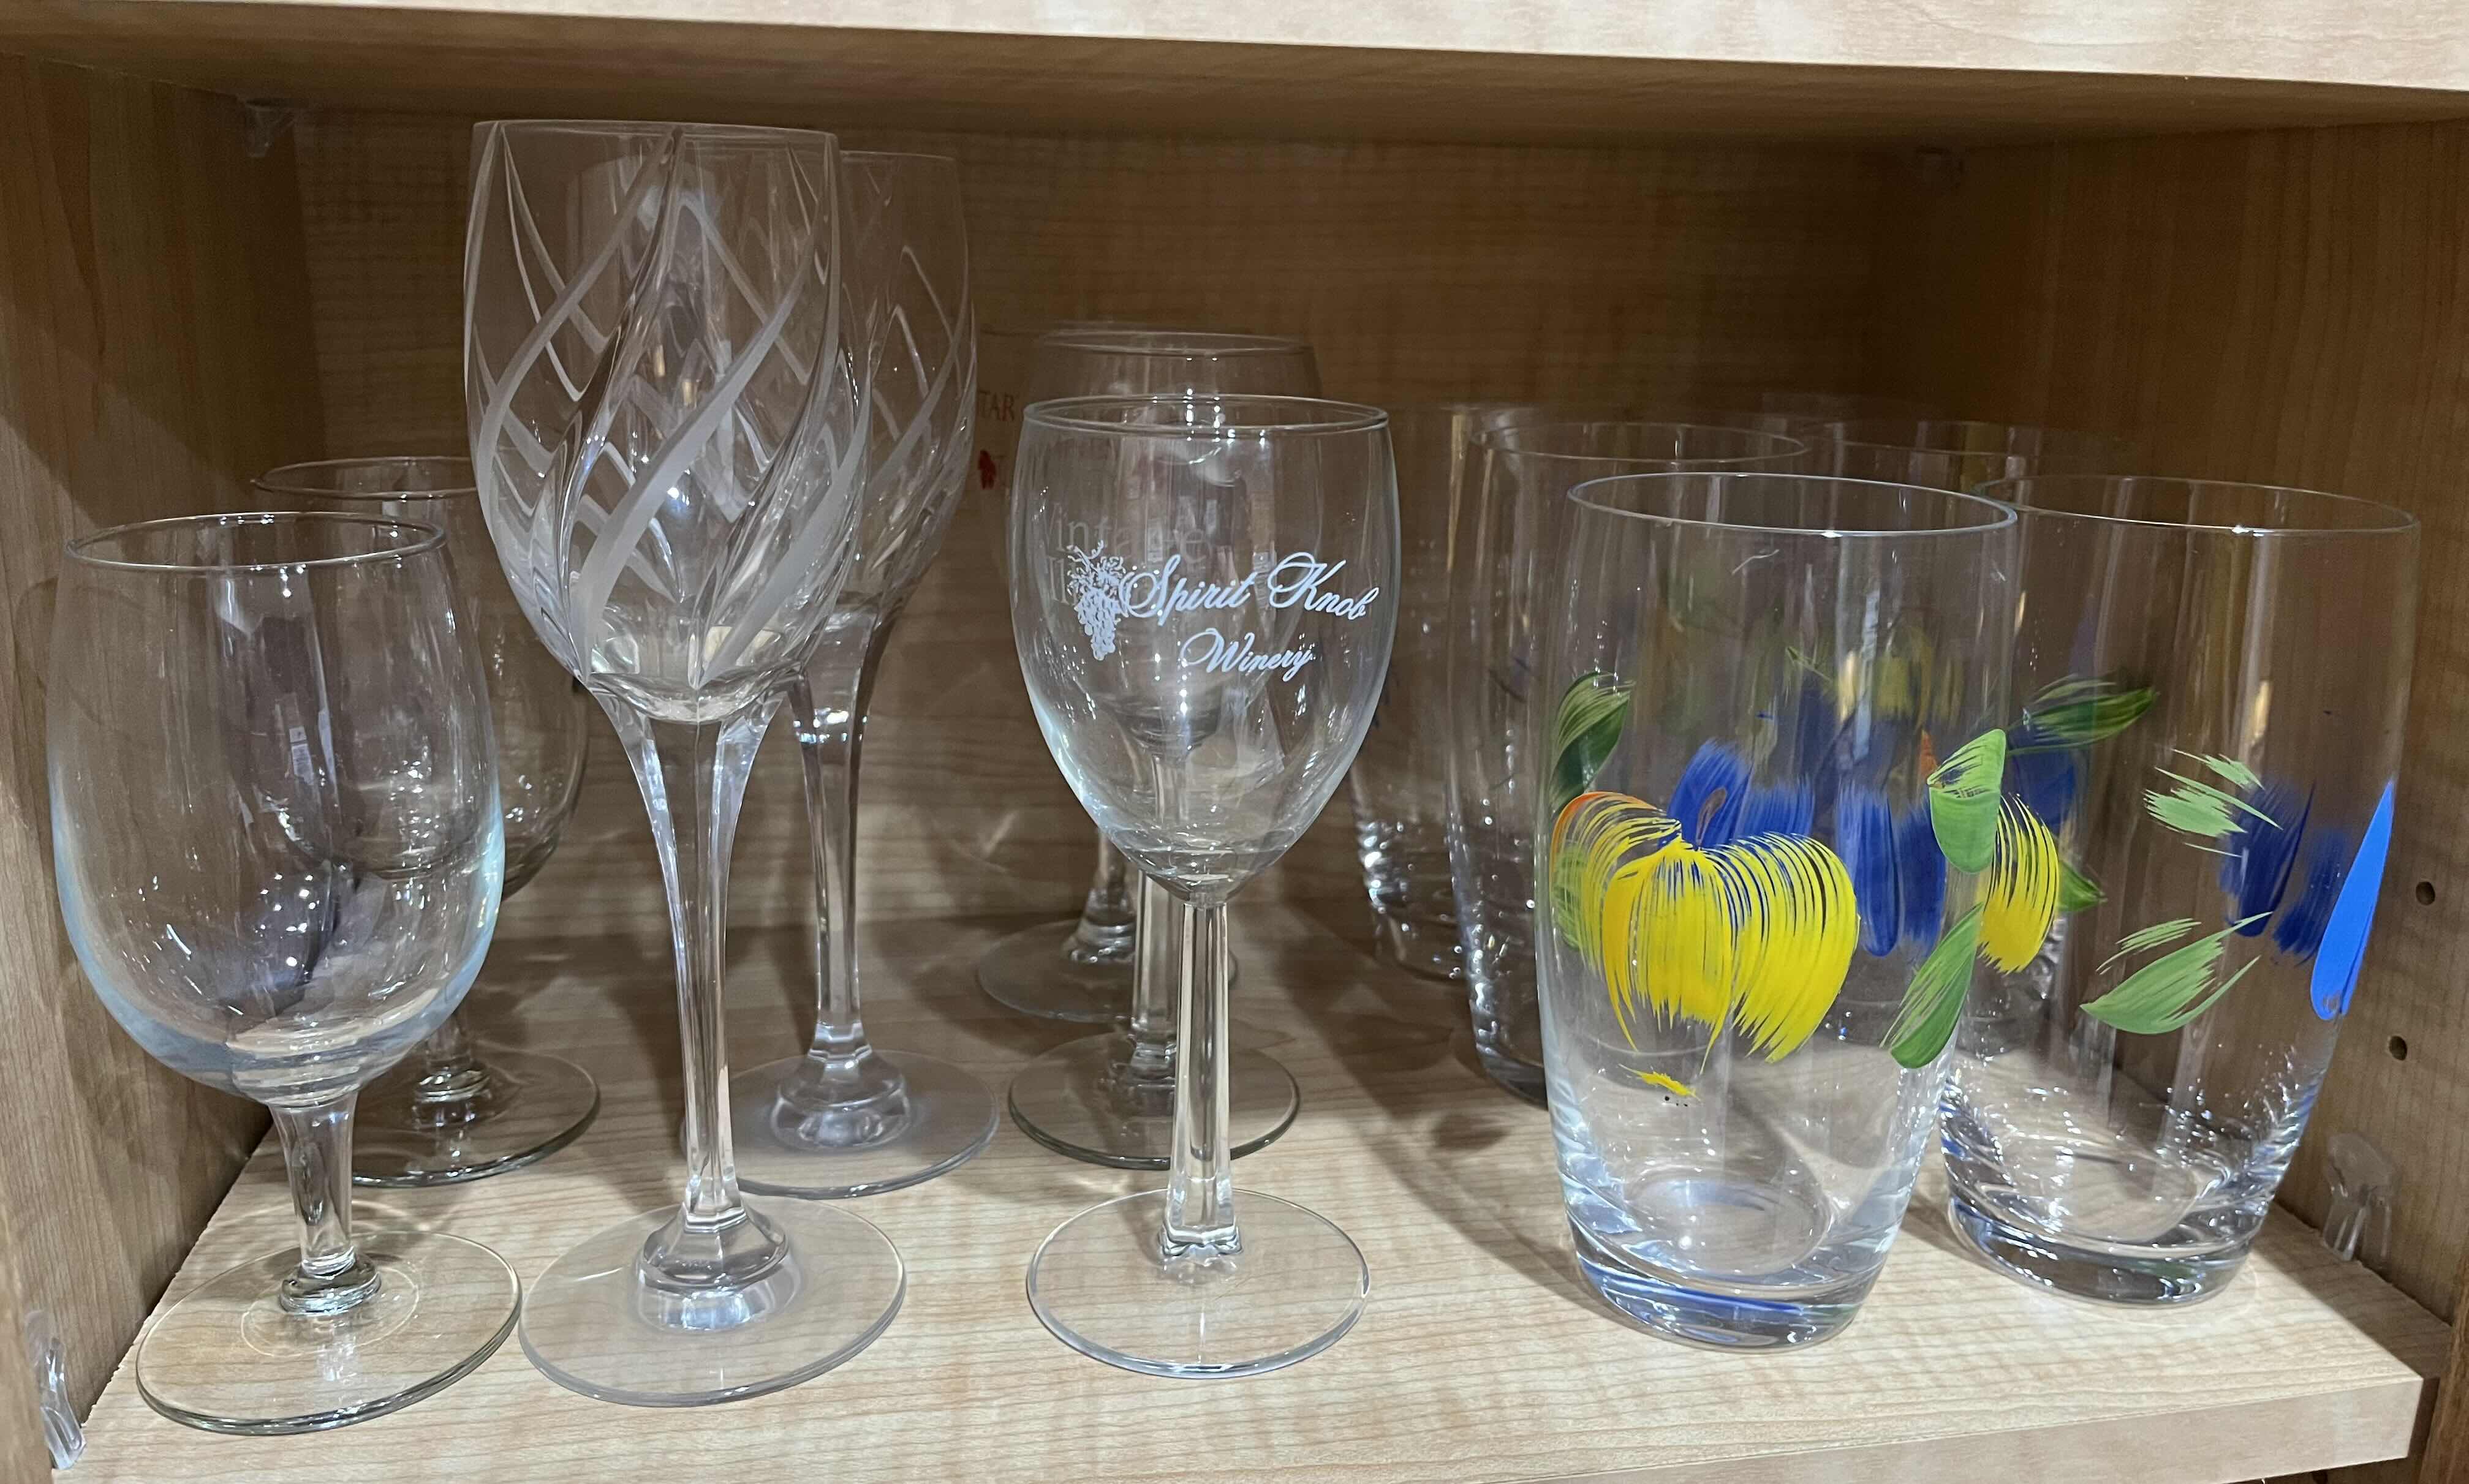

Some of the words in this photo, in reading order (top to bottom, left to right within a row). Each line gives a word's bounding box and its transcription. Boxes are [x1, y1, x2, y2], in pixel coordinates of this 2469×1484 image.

[1118, 554, 1259, 627] Spirit
[1268, 551, 1380, 620] Knob
[1179, 627, 1315, 682] Winery
